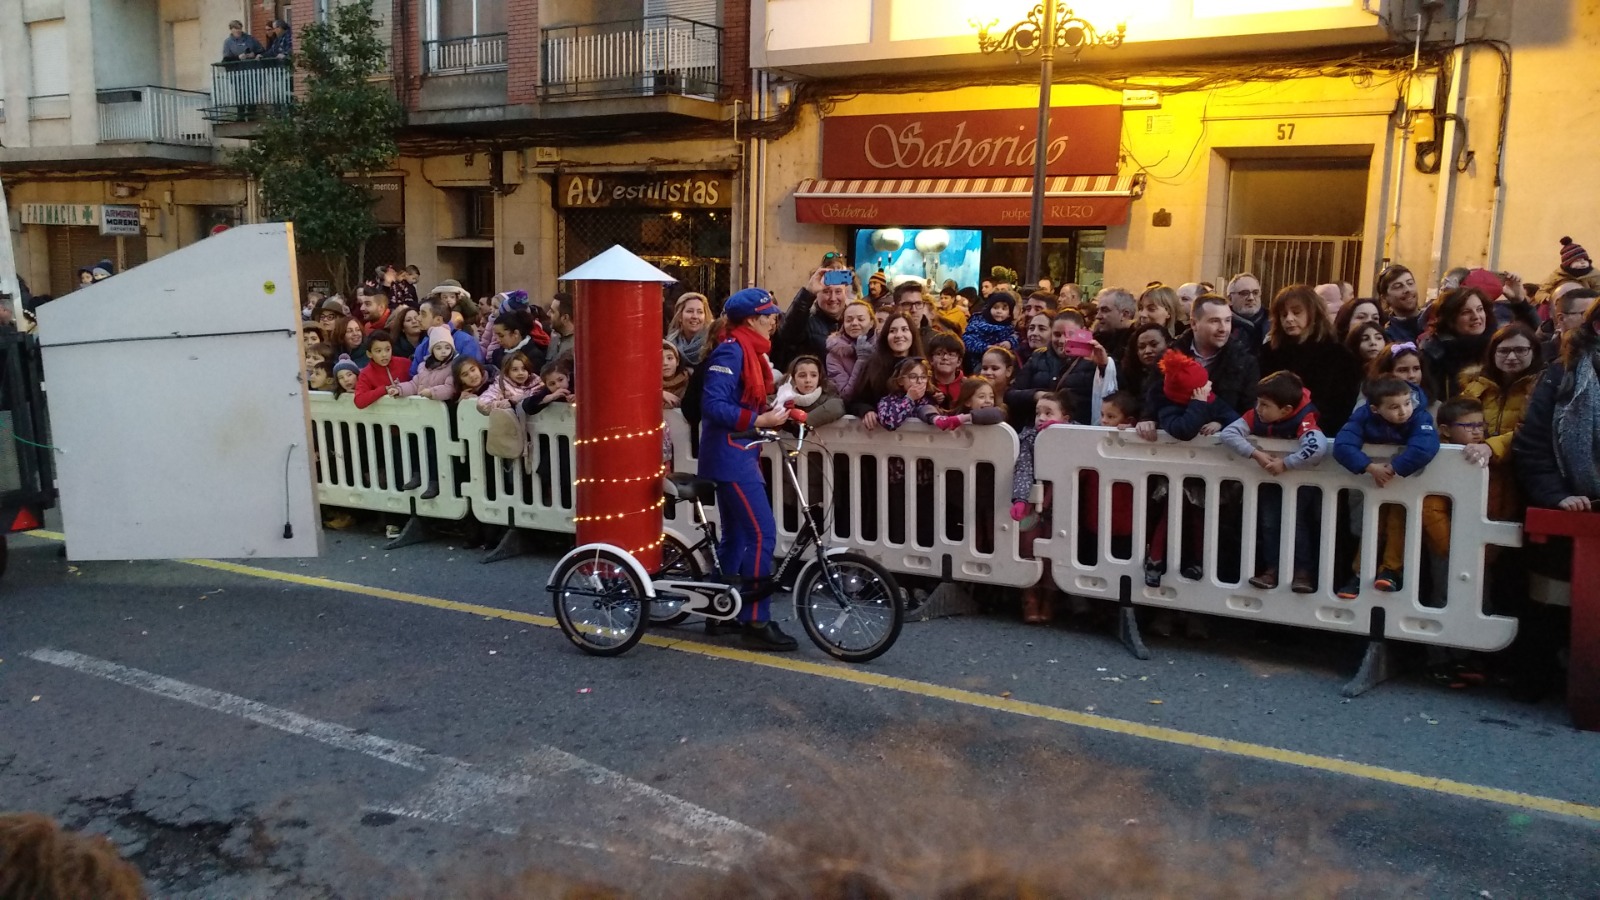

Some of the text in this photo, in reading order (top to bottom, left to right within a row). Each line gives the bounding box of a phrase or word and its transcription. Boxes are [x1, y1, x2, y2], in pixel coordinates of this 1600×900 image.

[1277, 123, 1296, 141] 57
[864, 117, 1069, 168] Saborido
[612, 178, 720, 205] estilistas
[27, 205, 77, 224] FARMACIA
[821, 203, 879, 218] Saborido
[1051, 205, 1094, 219] RUZO
[106, 218, 139, 226] MORENO
